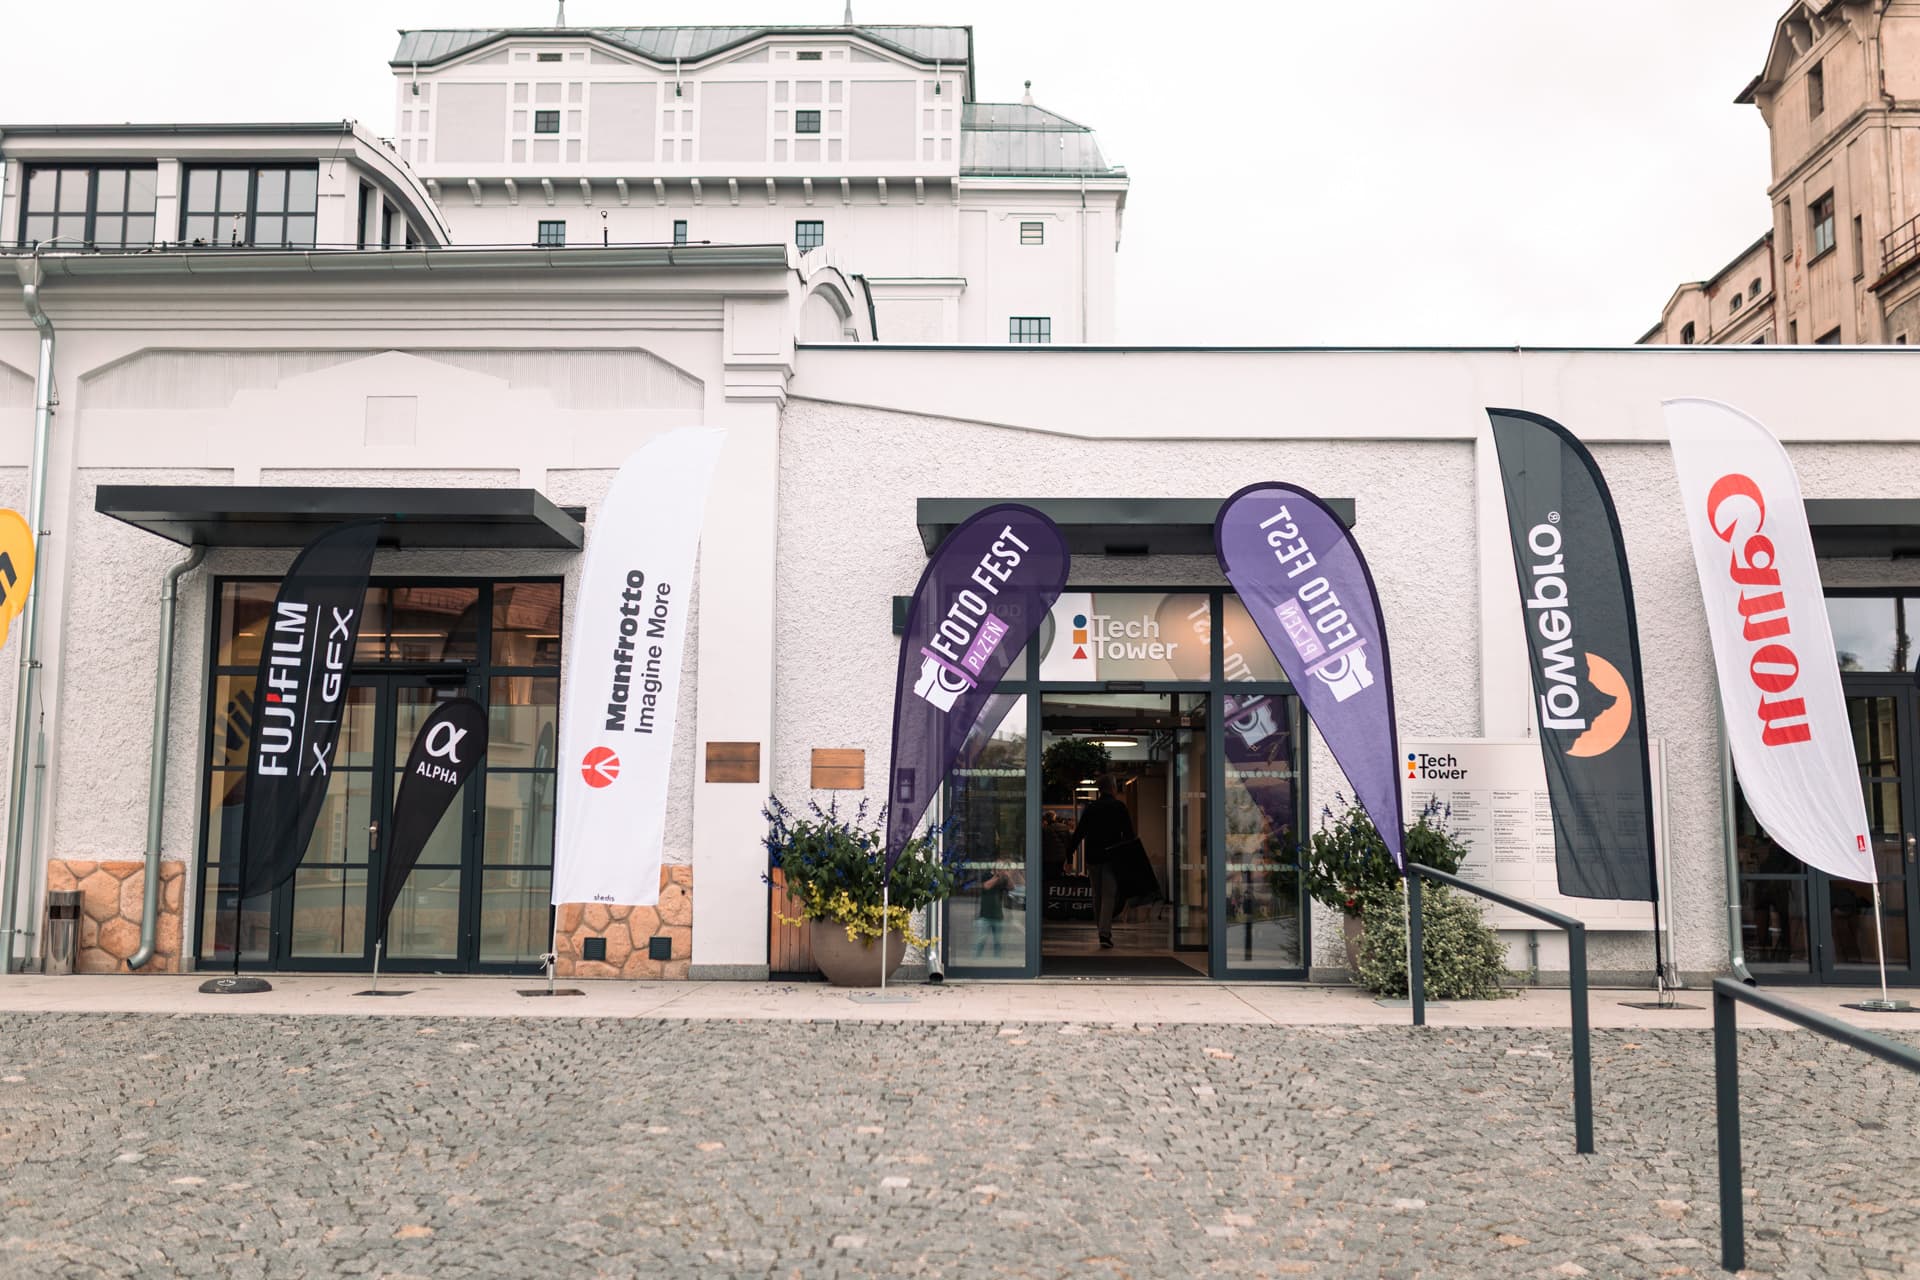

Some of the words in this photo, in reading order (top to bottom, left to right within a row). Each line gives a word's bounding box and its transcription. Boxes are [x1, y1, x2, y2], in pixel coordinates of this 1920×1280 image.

[646, 582, 671, 638] More
[930, 589, 987, 661] FOTO
[971, 525, 1029, 595] FEST
[605, 570, 644, 731] Manfrotto
[968, 621, 1003, 670] PLZEŇ
[1092, 615, 1159, 638] Tech
[1092, 635, 1178, 660] Tower
[258, 602, 308, 776] FUJIFILM
[311, 742, 331, 776] X
[322, 607, 353, 703] GFX
[634, 645, 662, 733] Imagine
[416, 760, 457, 785] ALPHA
[1418, 753, 1457, 768] Tech
[1418, 766, 1468, 779] Tower
[1072, 902, 1093, 910] GF
